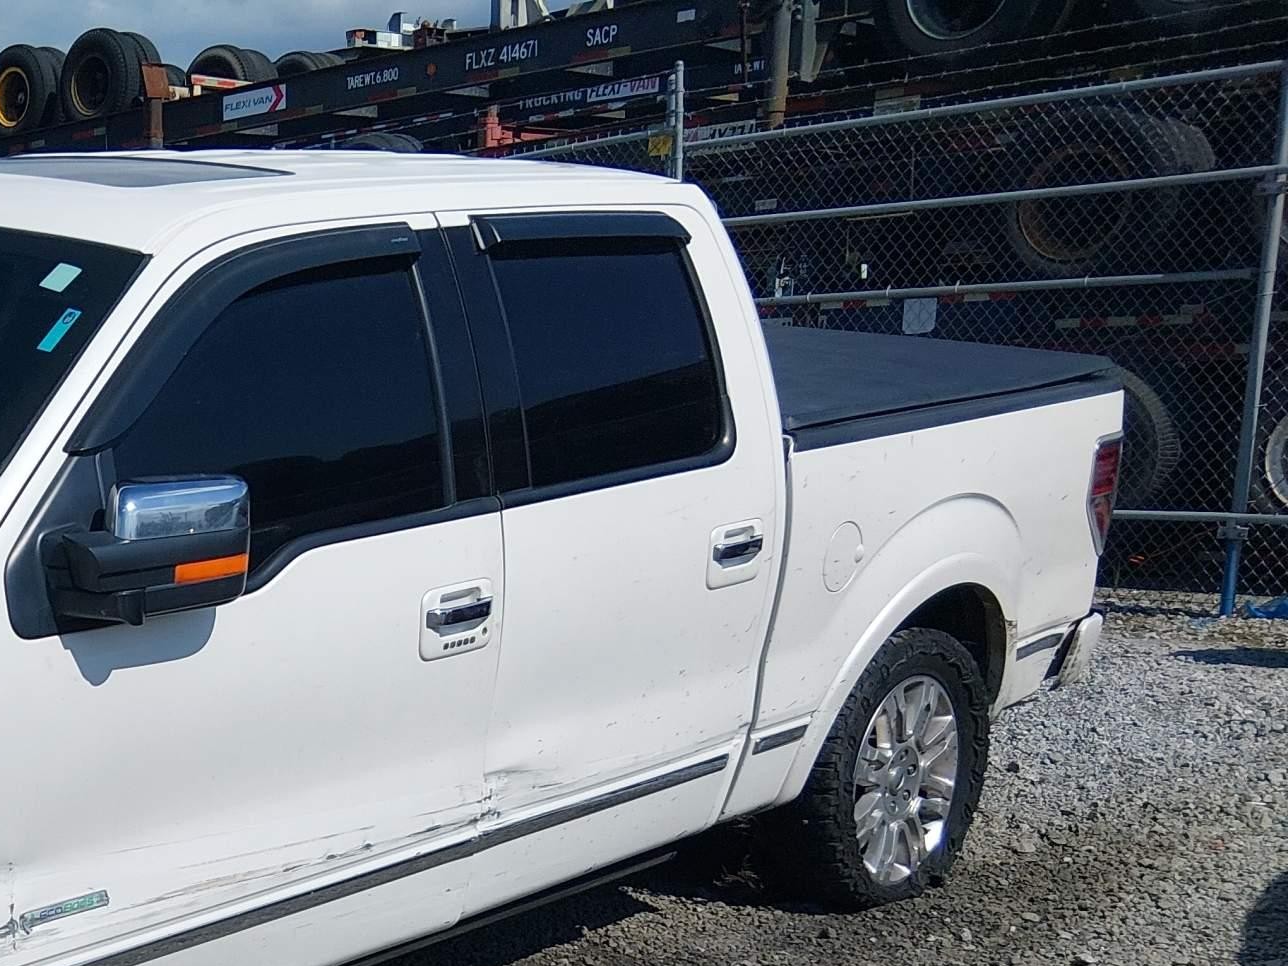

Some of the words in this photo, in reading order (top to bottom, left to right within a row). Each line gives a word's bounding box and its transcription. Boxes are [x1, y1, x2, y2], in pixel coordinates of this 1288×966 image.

[585, 24, 618, 47] SACP
[465, 48, 496, 71] FLXZ
[499, 39, 539, 64] 414671
